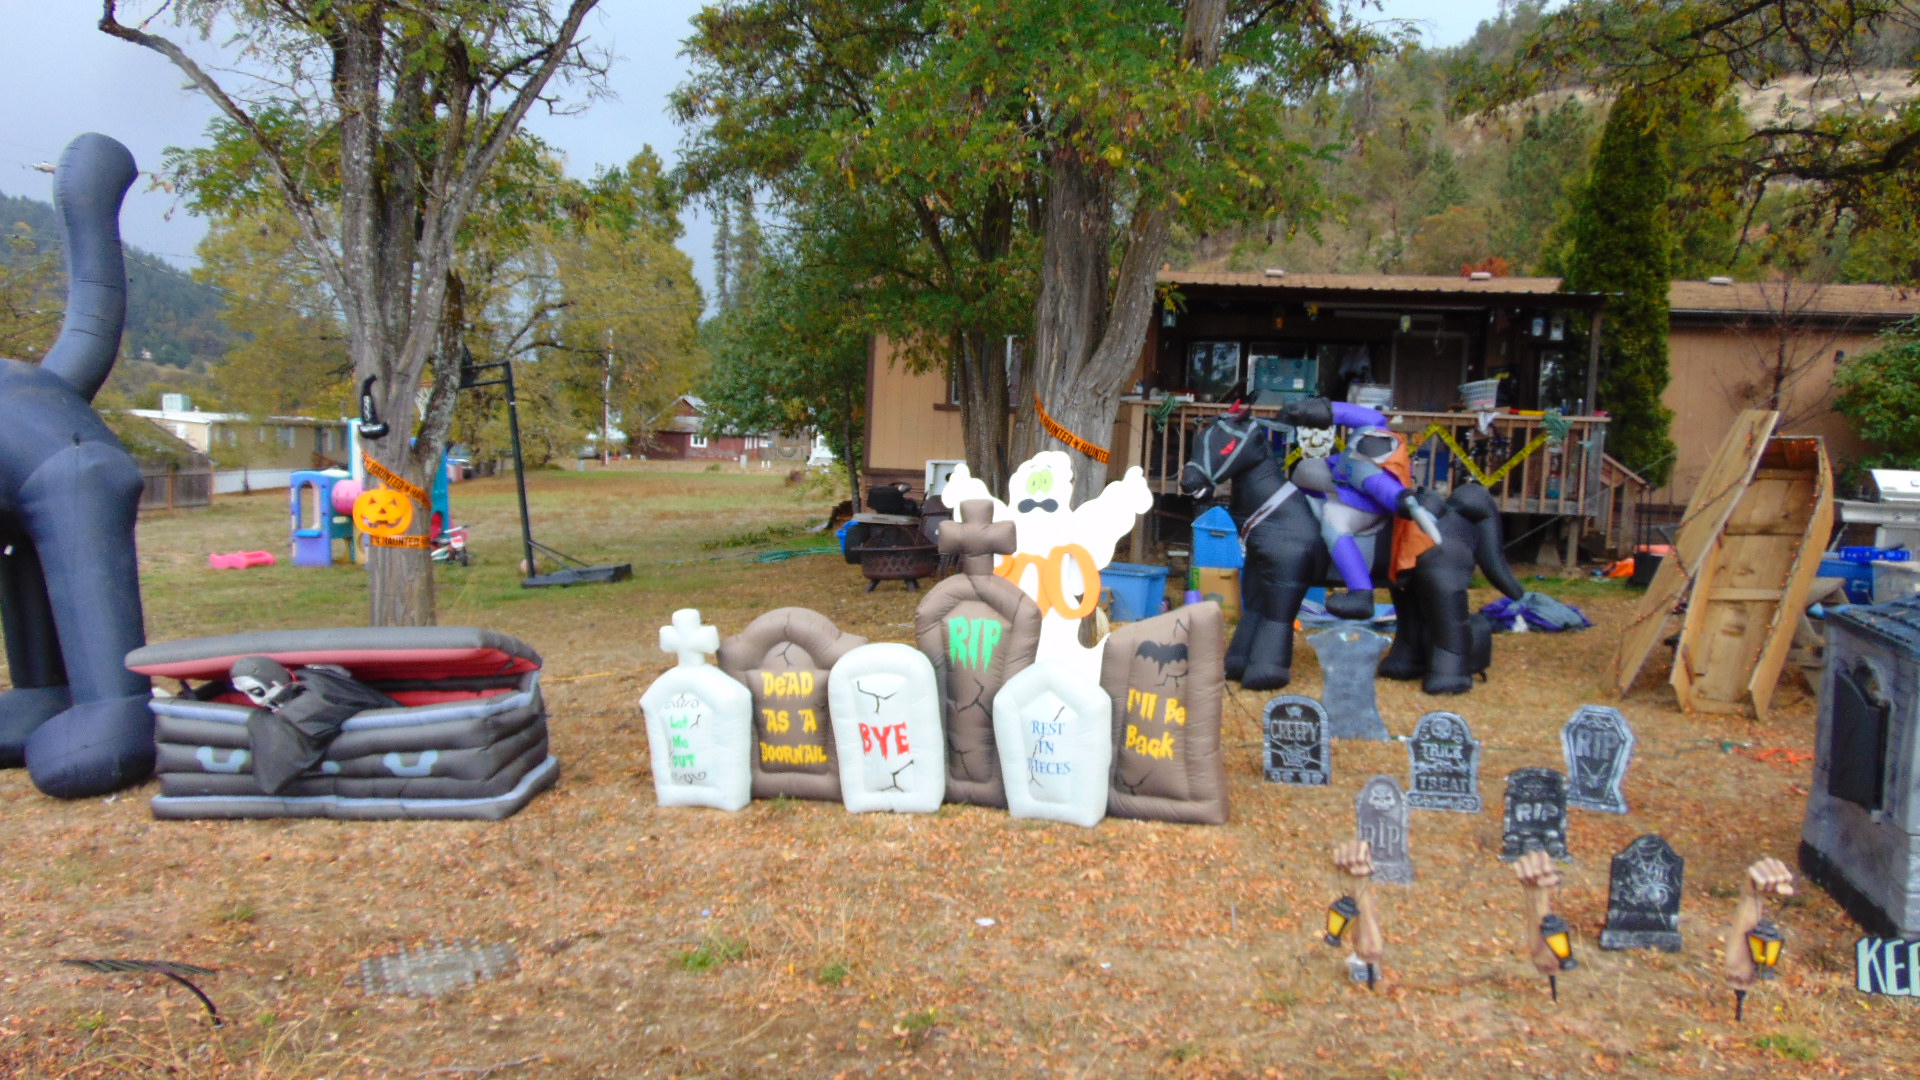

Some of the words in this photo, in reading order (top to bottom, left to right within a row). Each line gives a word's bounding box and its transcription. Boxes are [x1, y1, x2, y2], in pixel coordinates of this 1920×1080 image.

[369, 463, 404, 490] HAUNTED
[383, 536, 420, 547] HAUNTED
[993, 544, 1100, 619] OO
[948, 615, 1003, 673] RIP
[762, 709, 790, 735] AS
[798, 709, 818, 734] A
[1165, 698, 1187, 727] Be
[1032, 720, 1066, 736] REST
[1271, 720, 1320, 742] CREEPY
[858, 722, 911, 760] BYE
[1036, 740, 1055, 755] IN
[1126, 725, 1176, 760] Back
[1421, 743, 1464, 759] TRICK
[1576, 728, 1618, 760] RIP
[760, 742, 829, 765] DOORNAIL
[1028, 758, 1071, 775] PIECES
[1419, 776, 1468, 792] TREAT
[1515, 803, 1559, 821] RIP
